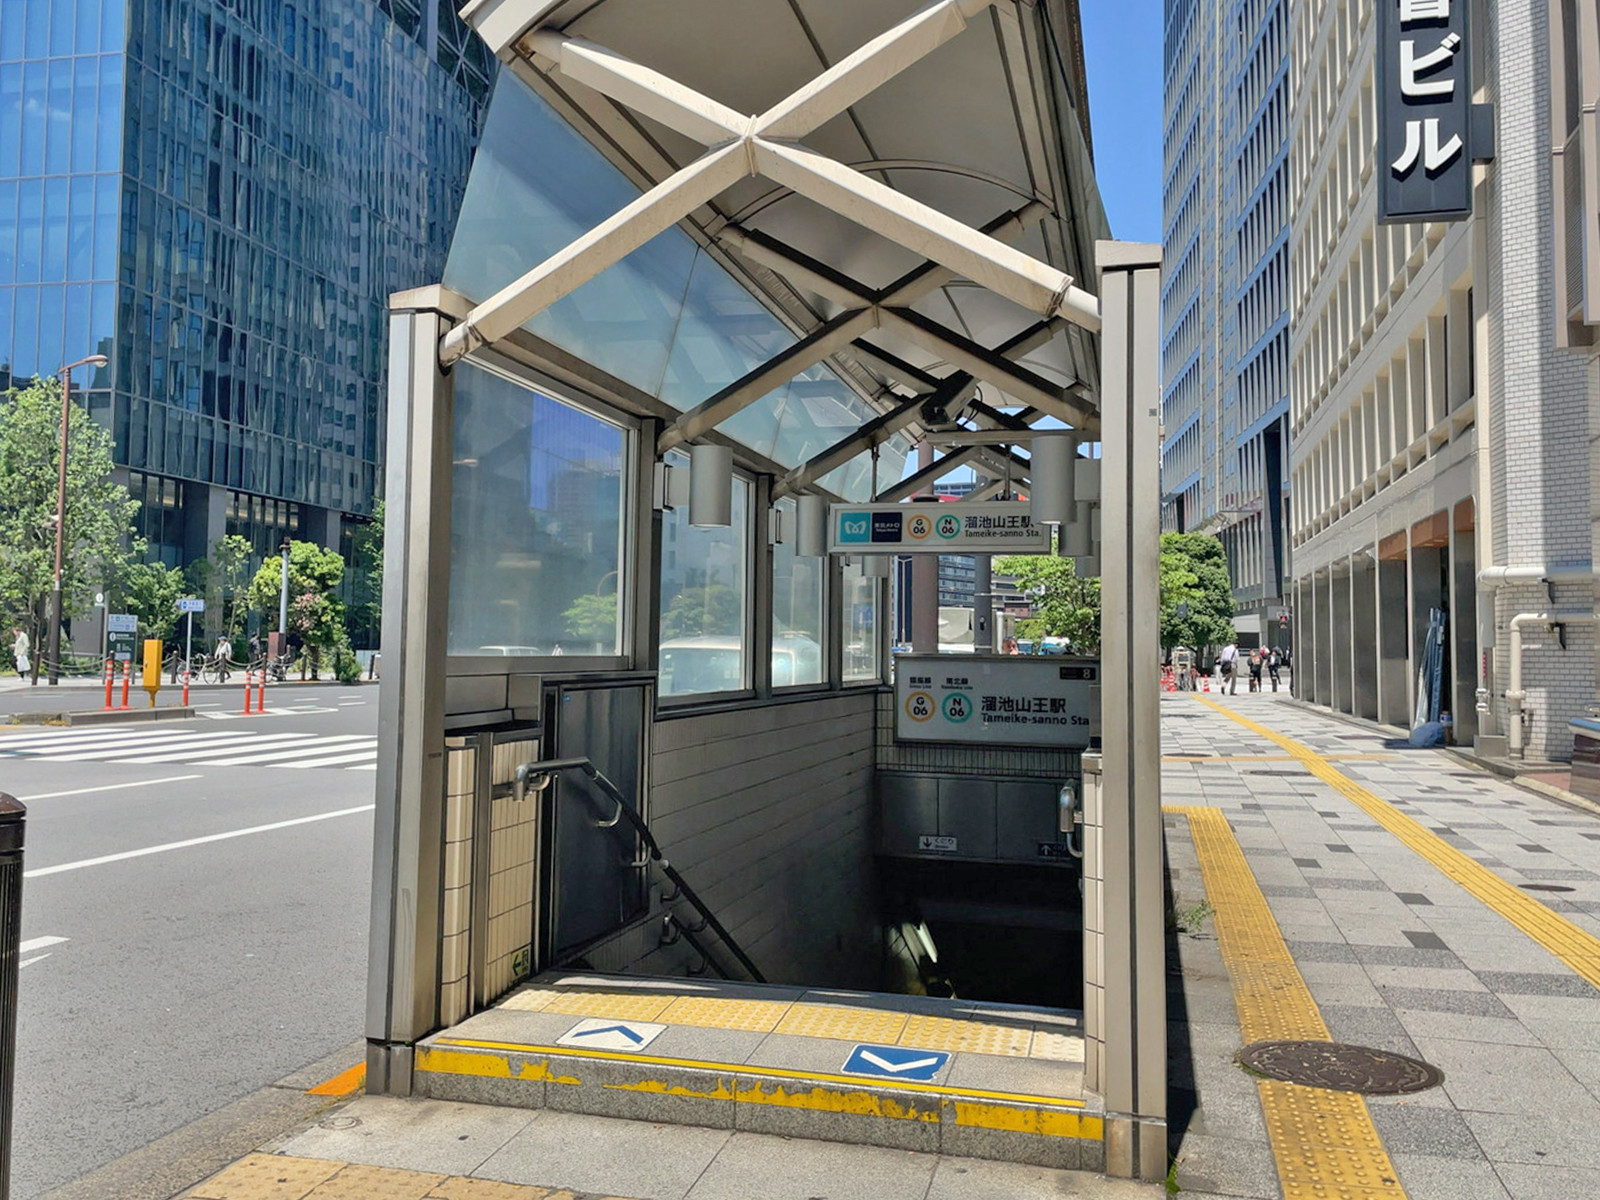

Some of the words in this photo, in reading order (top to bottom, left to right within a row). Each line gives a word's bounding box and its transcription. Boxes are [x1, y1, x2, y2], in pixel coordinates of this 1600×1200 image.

[915, 518, 923, 526] G
[913, 526, 926, 534] 06
[941, 526, 954, 534] 06
[965, 529, 1023, 538] Tameike-sanno
[1026, 529, 1042, 537] Sta.
[1083, 668, 1091, 679] 8
[916, 696, 925, 705] G
[952, 697, 962, 706] N
[981, 696, 1066, 713] 溜池山王駅
[913, 705, 928, 715] 06
[949, 707, 964, 717] 06
[981, 713, 1067, 725] Tameike-sanno
